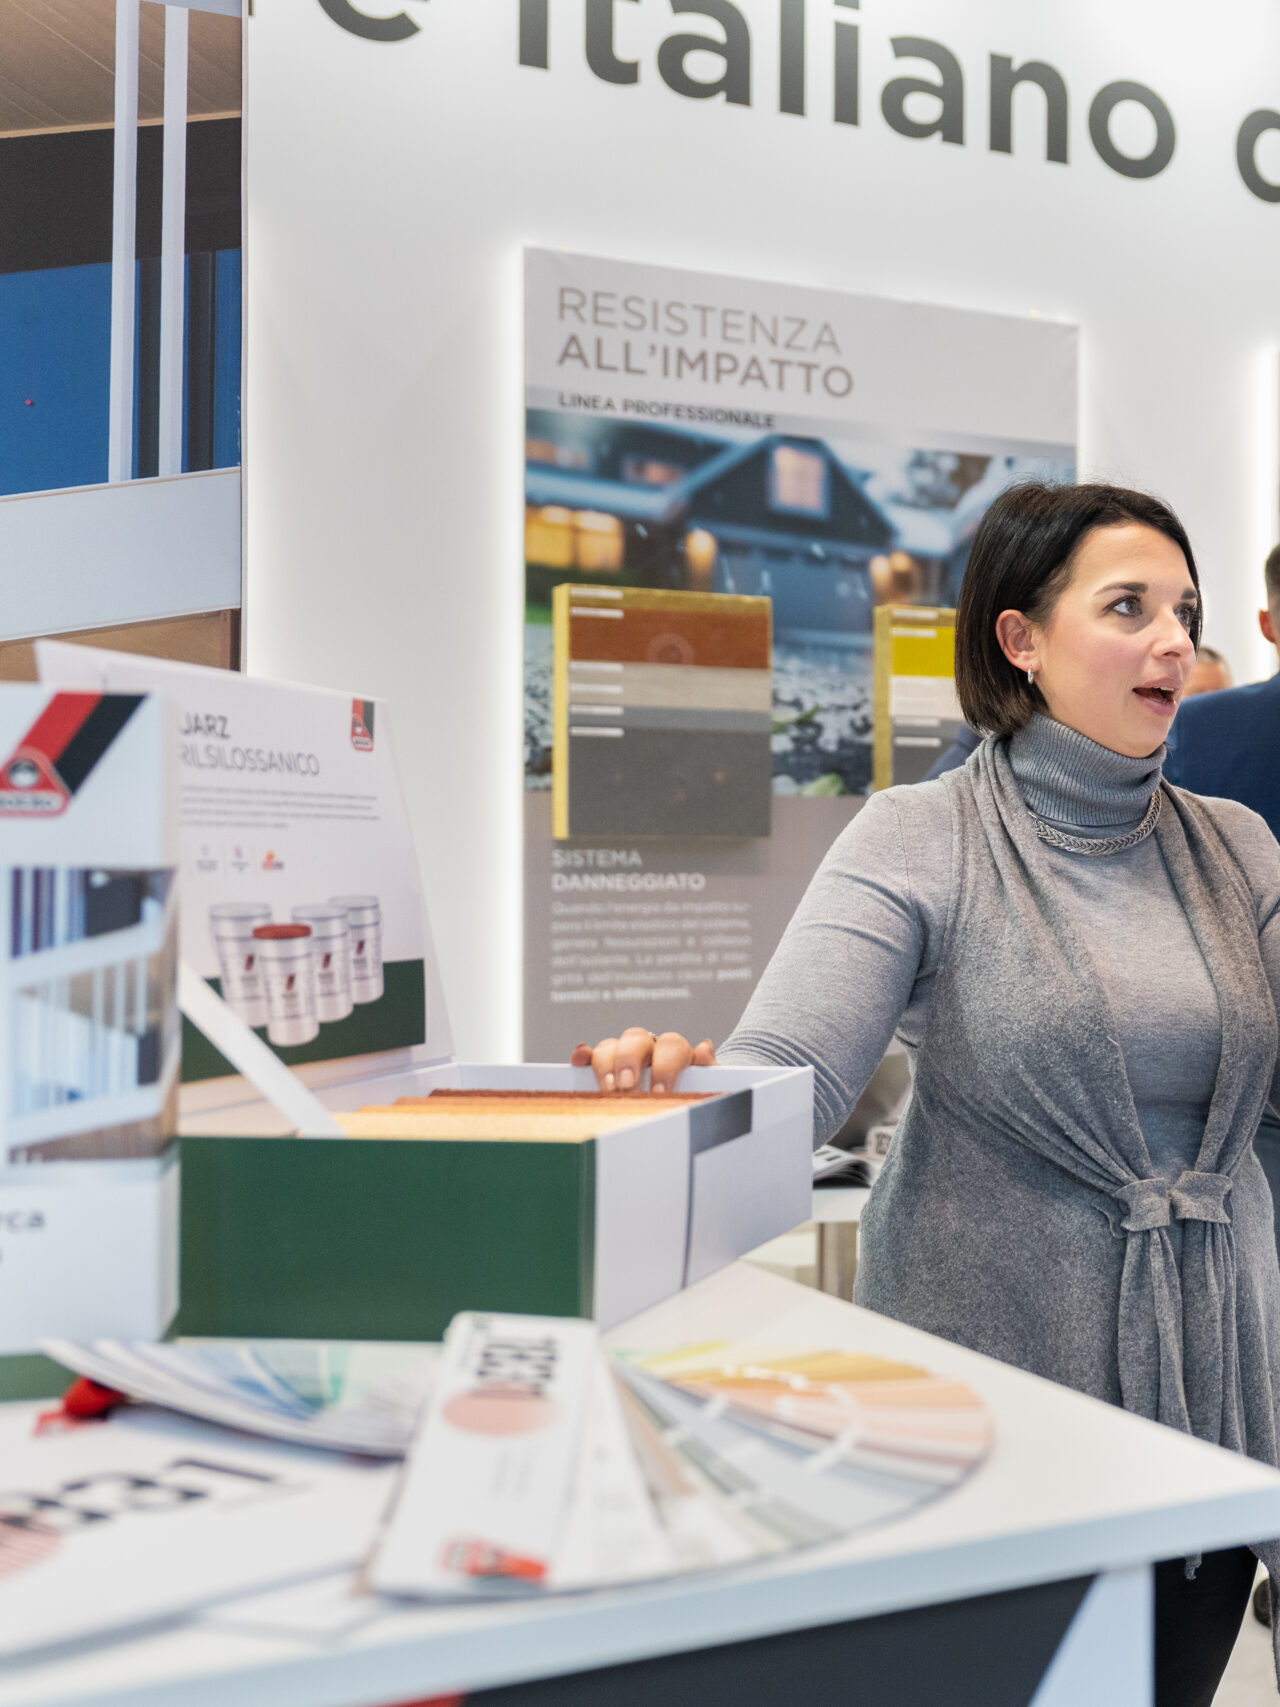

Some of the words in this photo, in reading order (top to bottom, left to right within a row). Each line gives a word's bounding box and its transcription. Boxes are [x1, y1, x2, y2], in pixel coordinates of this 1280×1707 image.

[558, 286, 843, 356] RESISTENZA
[558, 392, 617, 412] LINEA
[622, 398, 776, 428] PROFESSIONALE
[552, 849, 643, 868] SISTEMA
[552, 872, 706, 892] DANNEGGIATO
